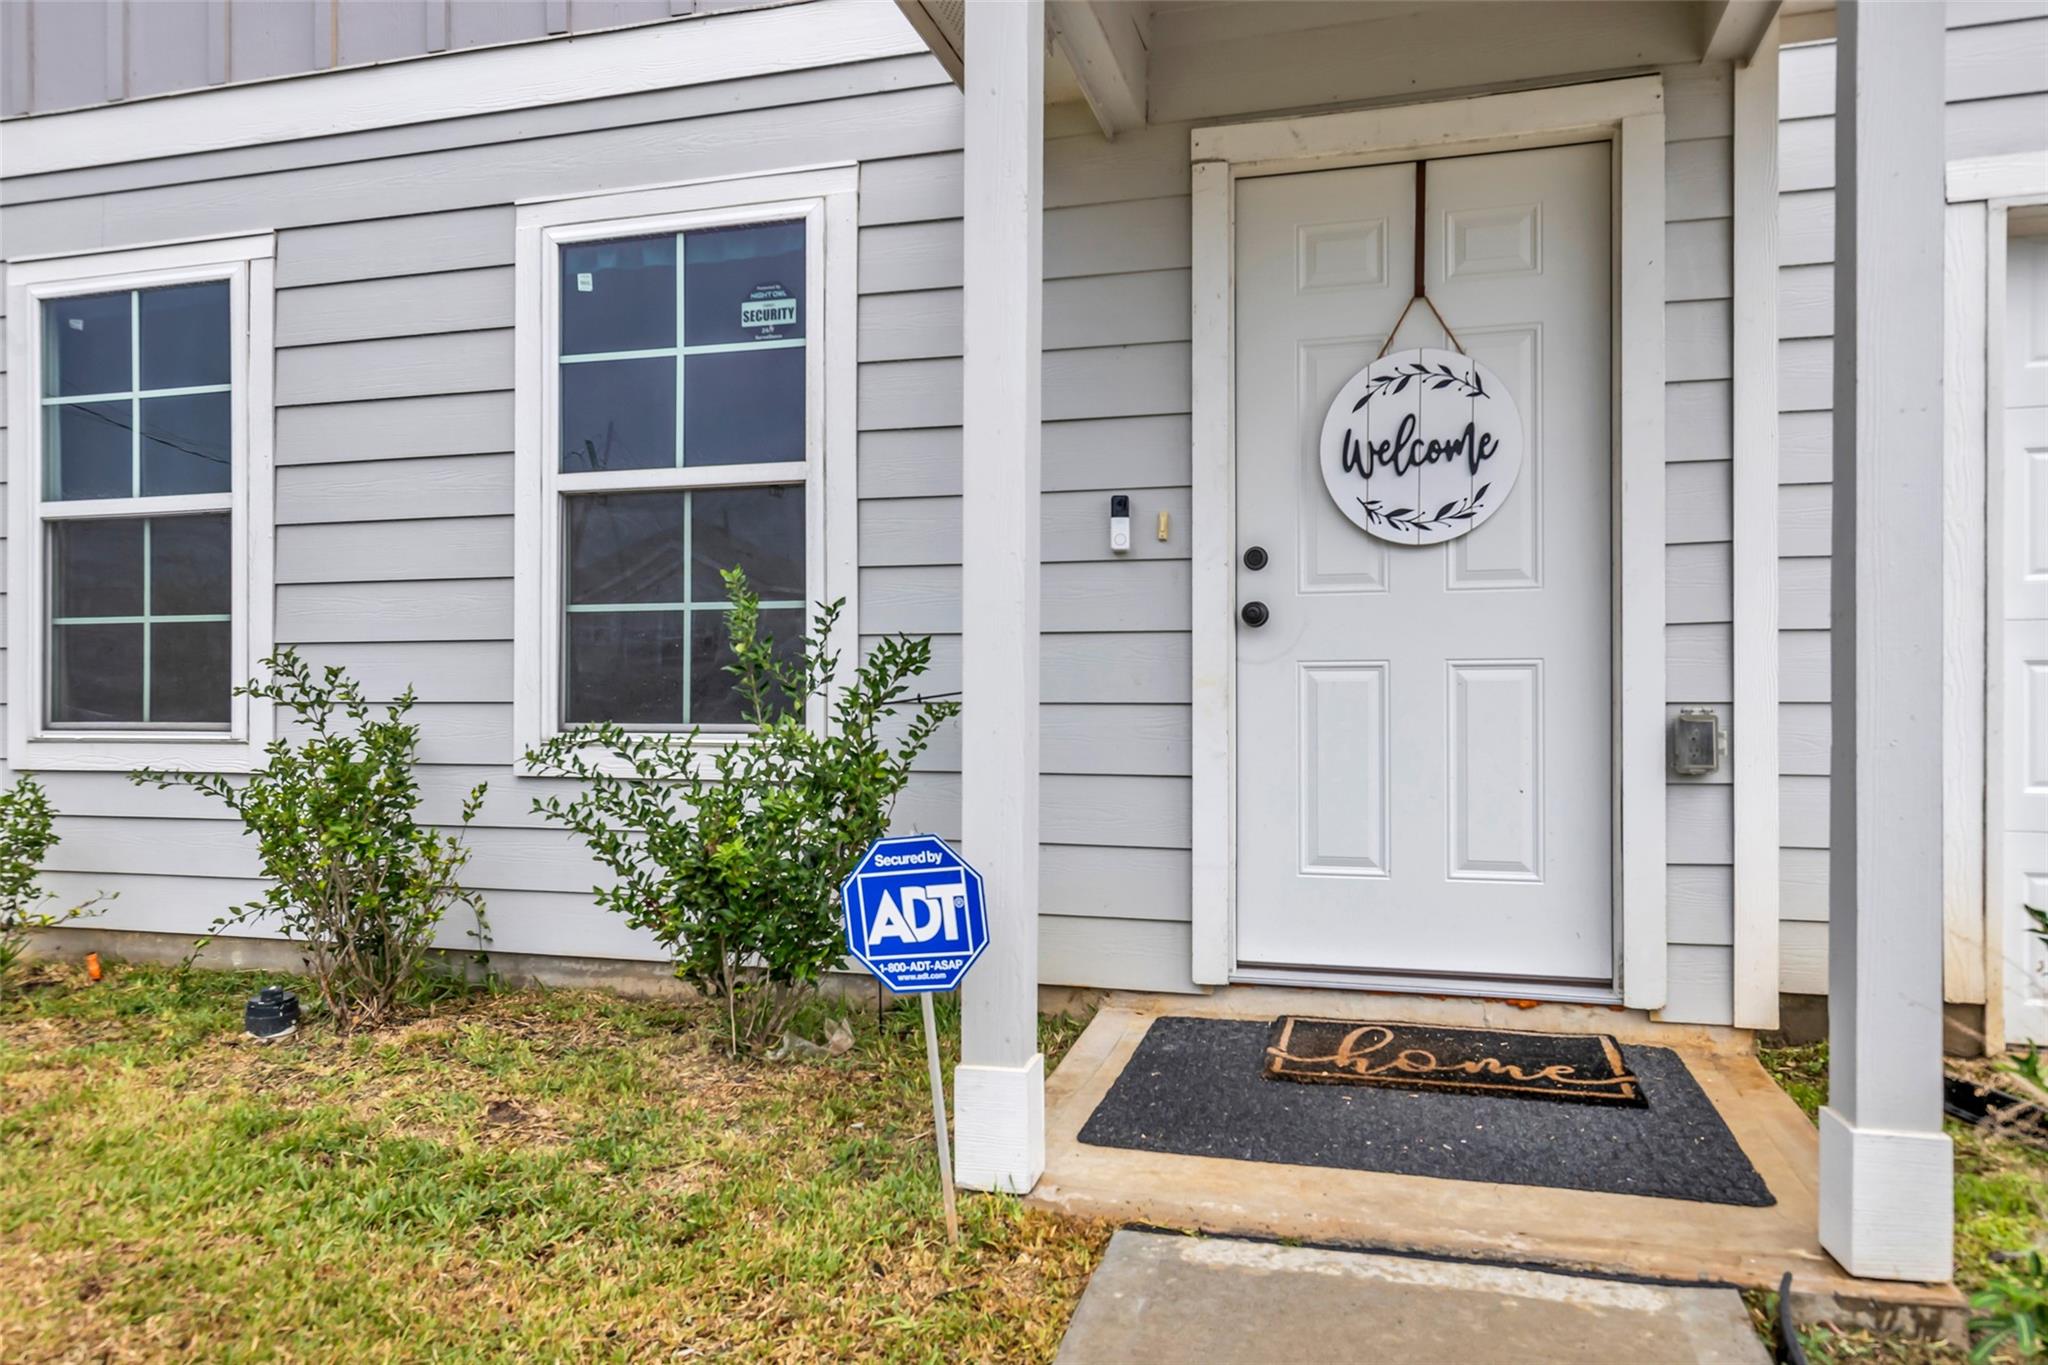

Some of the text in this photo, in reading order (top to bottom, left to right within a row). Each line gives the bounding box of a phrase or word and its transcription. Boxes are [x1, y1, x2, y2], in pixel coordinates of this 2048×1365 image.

[743, 307, 794, 323] SECURITY
[1342, 413, 1500, 480] Welcome
[874, 850, 943, 867] Secured by
[868, 883, 966, 946] ADT
[878, 959, 964, 974] 1-800-ADT-ASAP
[897, 972, 947, 981] www.adt.com
[1334, 1025, 1590, 1084] home
